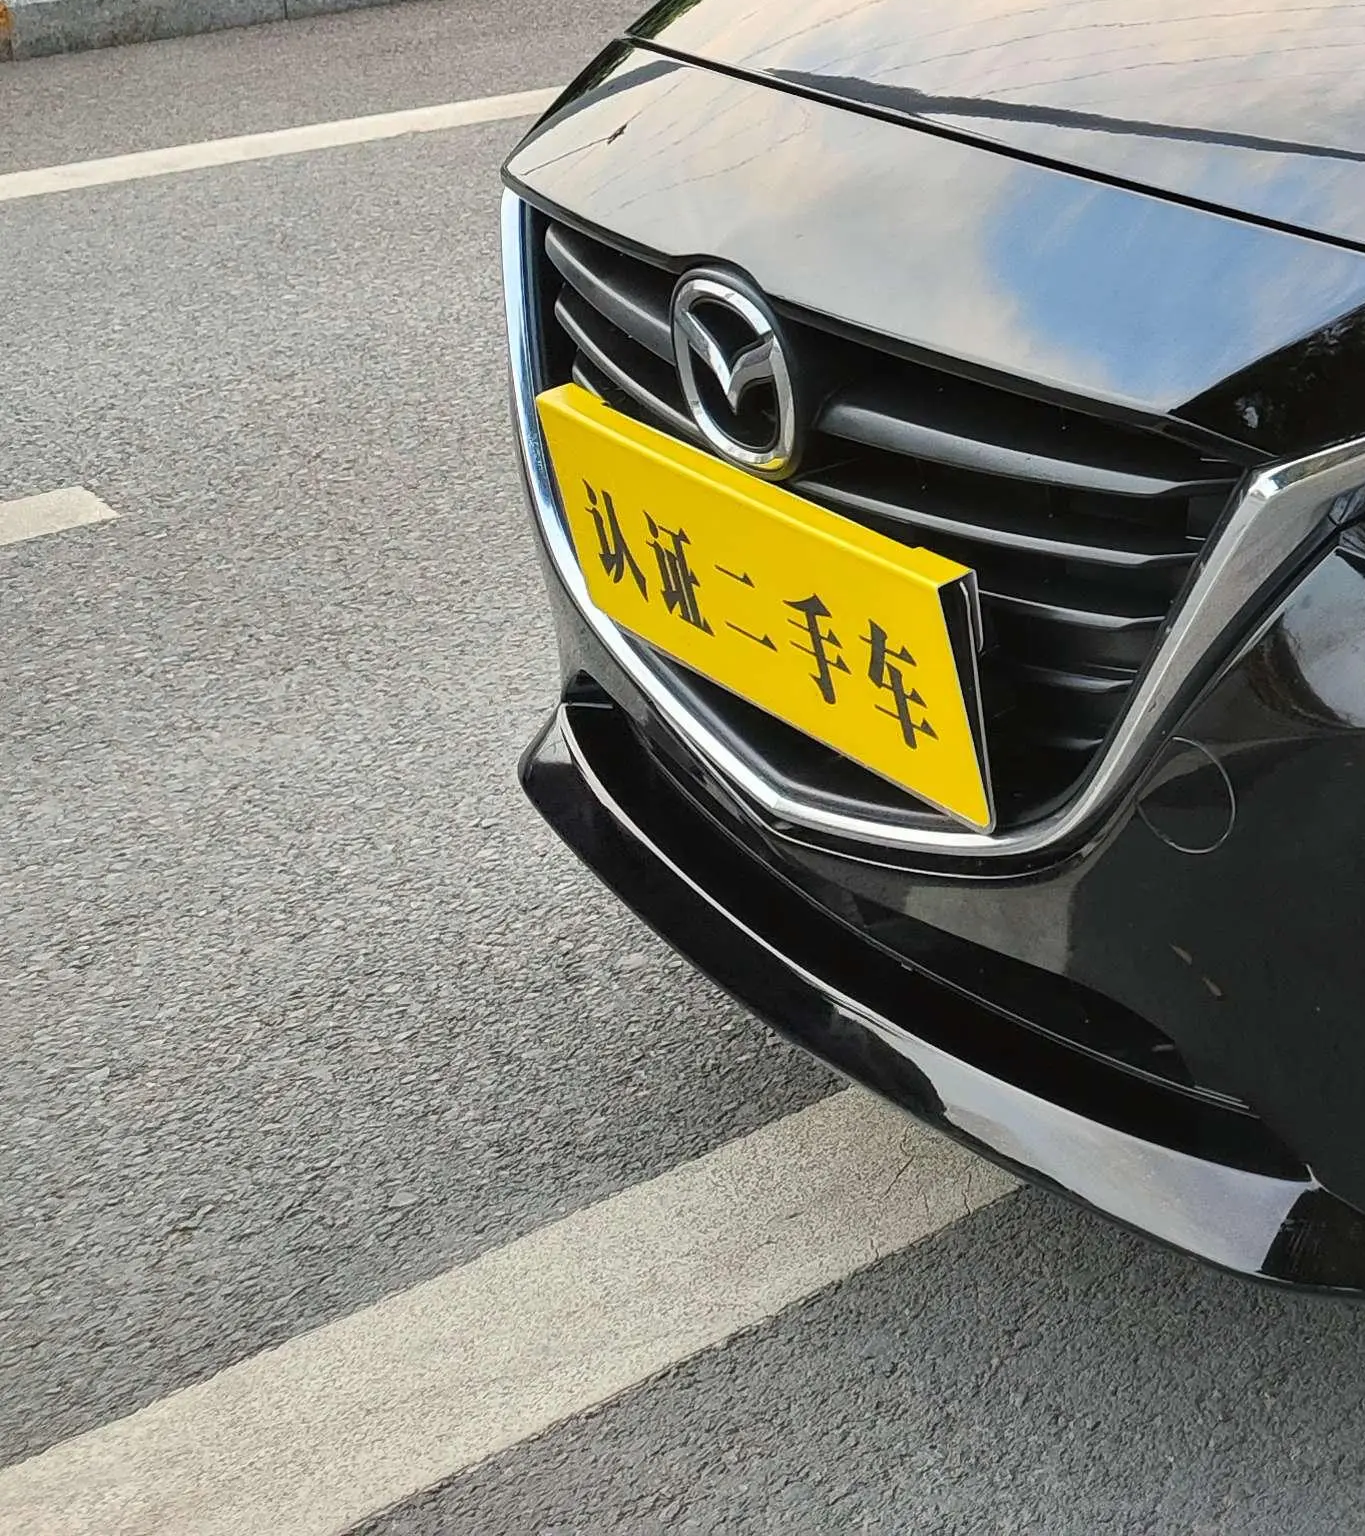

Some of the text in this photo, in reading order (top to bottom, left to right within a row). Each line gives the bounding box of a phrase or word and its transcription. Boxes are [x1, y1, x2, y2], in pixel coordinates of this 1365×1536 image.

[581, 478, 939, 750] 认证二手车
